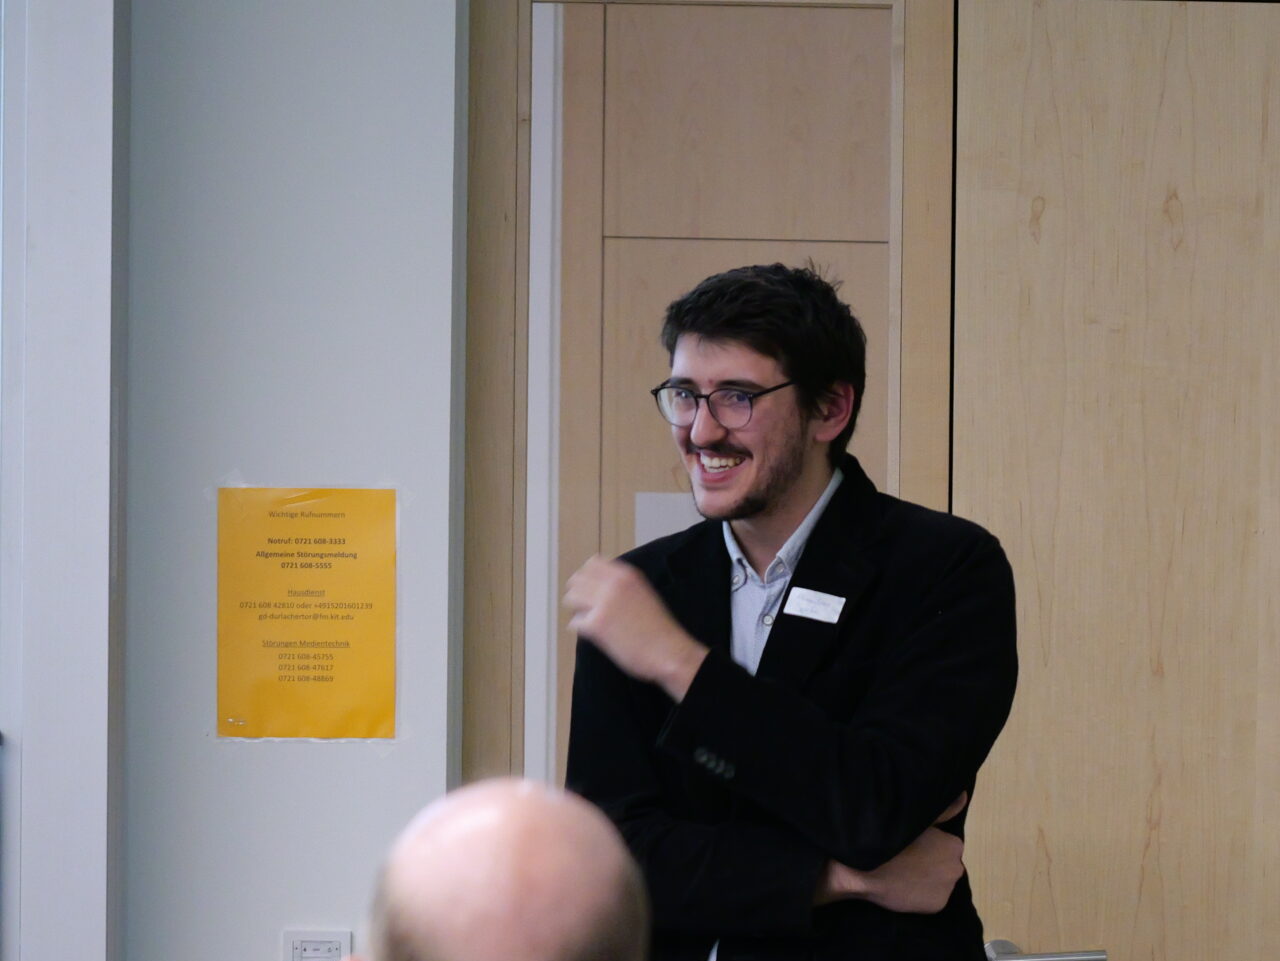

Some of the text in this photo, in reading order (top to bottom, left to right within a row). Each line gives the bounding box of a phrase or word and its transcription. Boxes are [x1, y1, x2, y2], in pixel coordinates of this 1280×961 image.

[267, 537, 292, 545] Notruf:
[294, 537, 312, 545] 0721
[256, 550, 358, 559] Allgemeine Störungsmeldung
